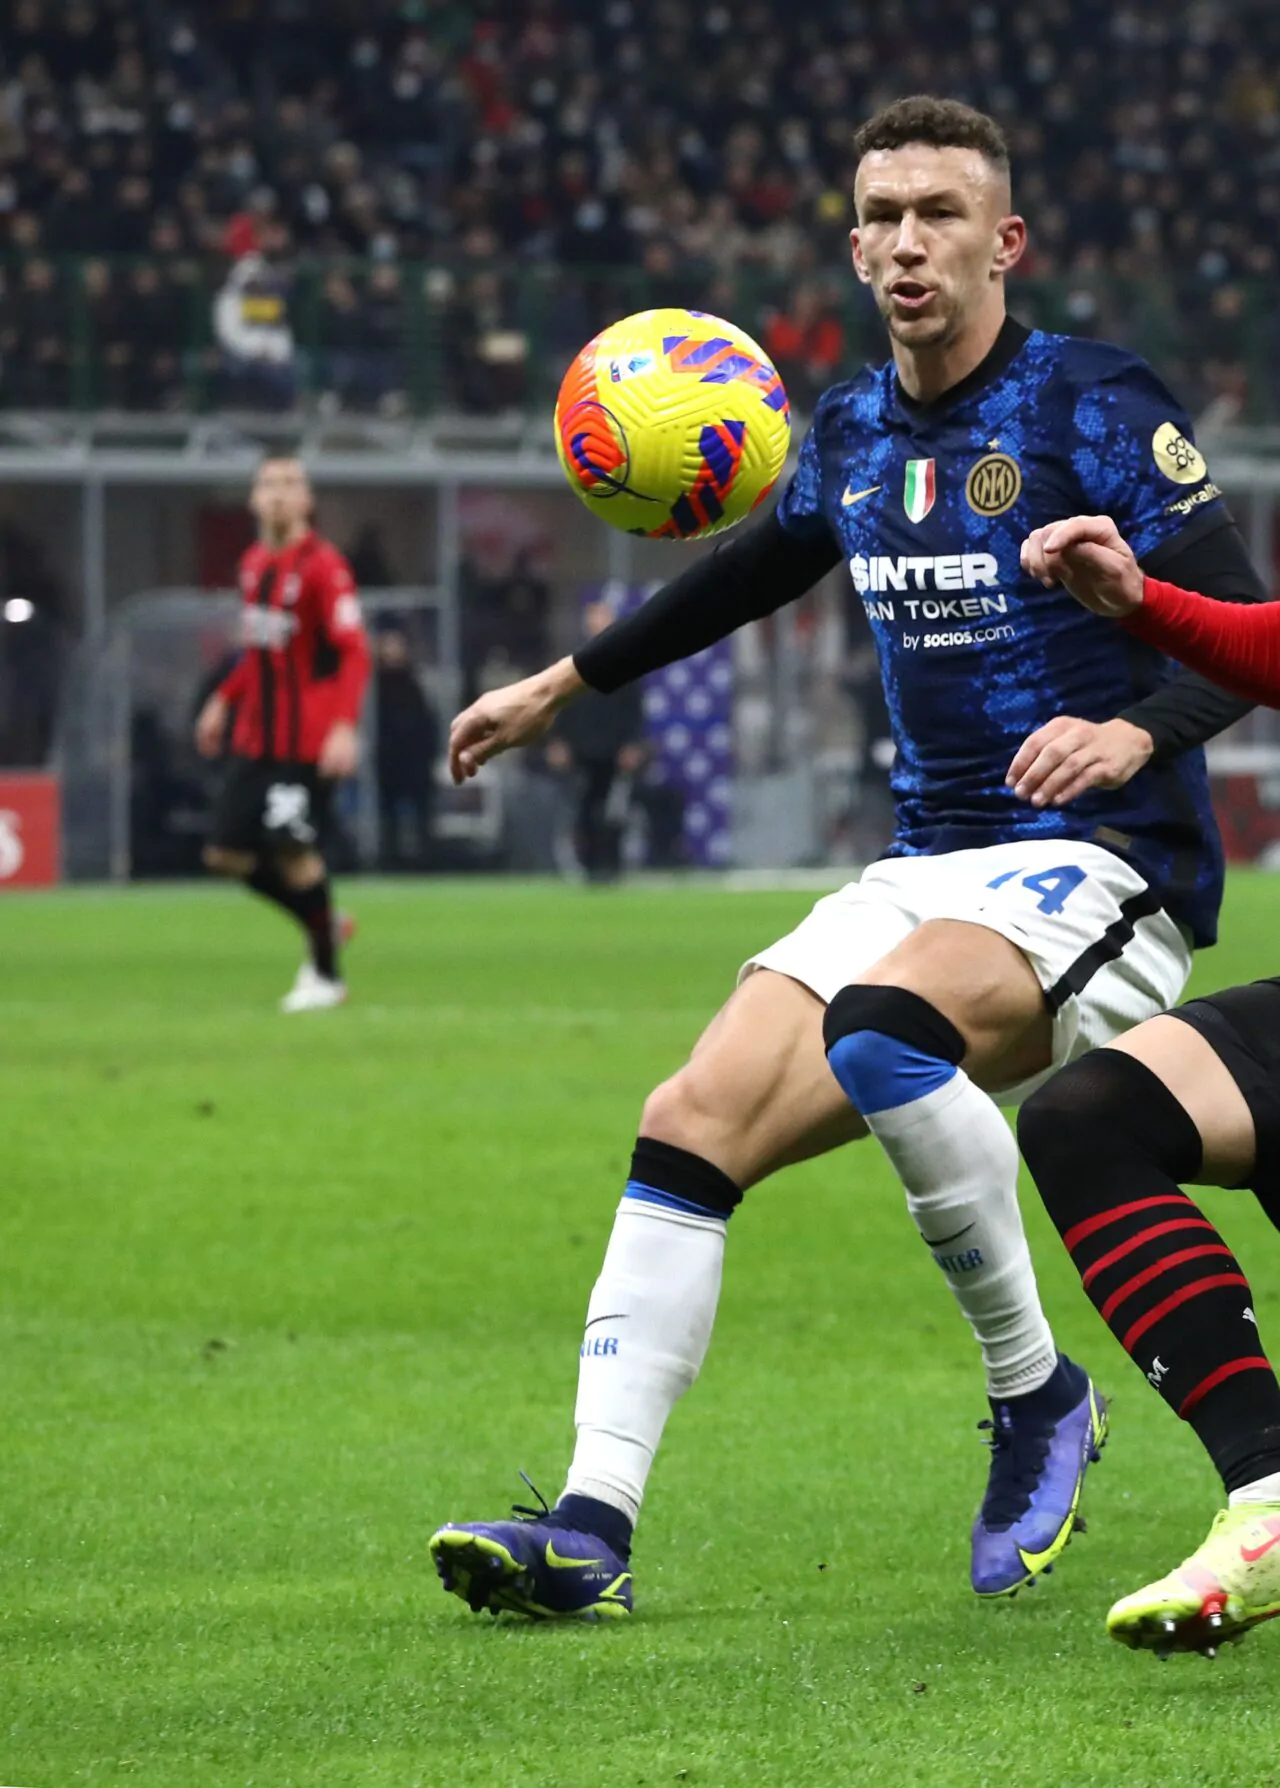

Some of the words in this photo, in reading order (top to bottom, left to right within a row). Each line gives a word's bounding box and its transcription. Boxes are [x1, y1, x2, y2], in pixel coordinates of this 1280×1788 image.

[904, 593, 1008, 619] TOKEN
[903, 632, 919, 651] by
[923, 624, 1015, 648] socios.com
